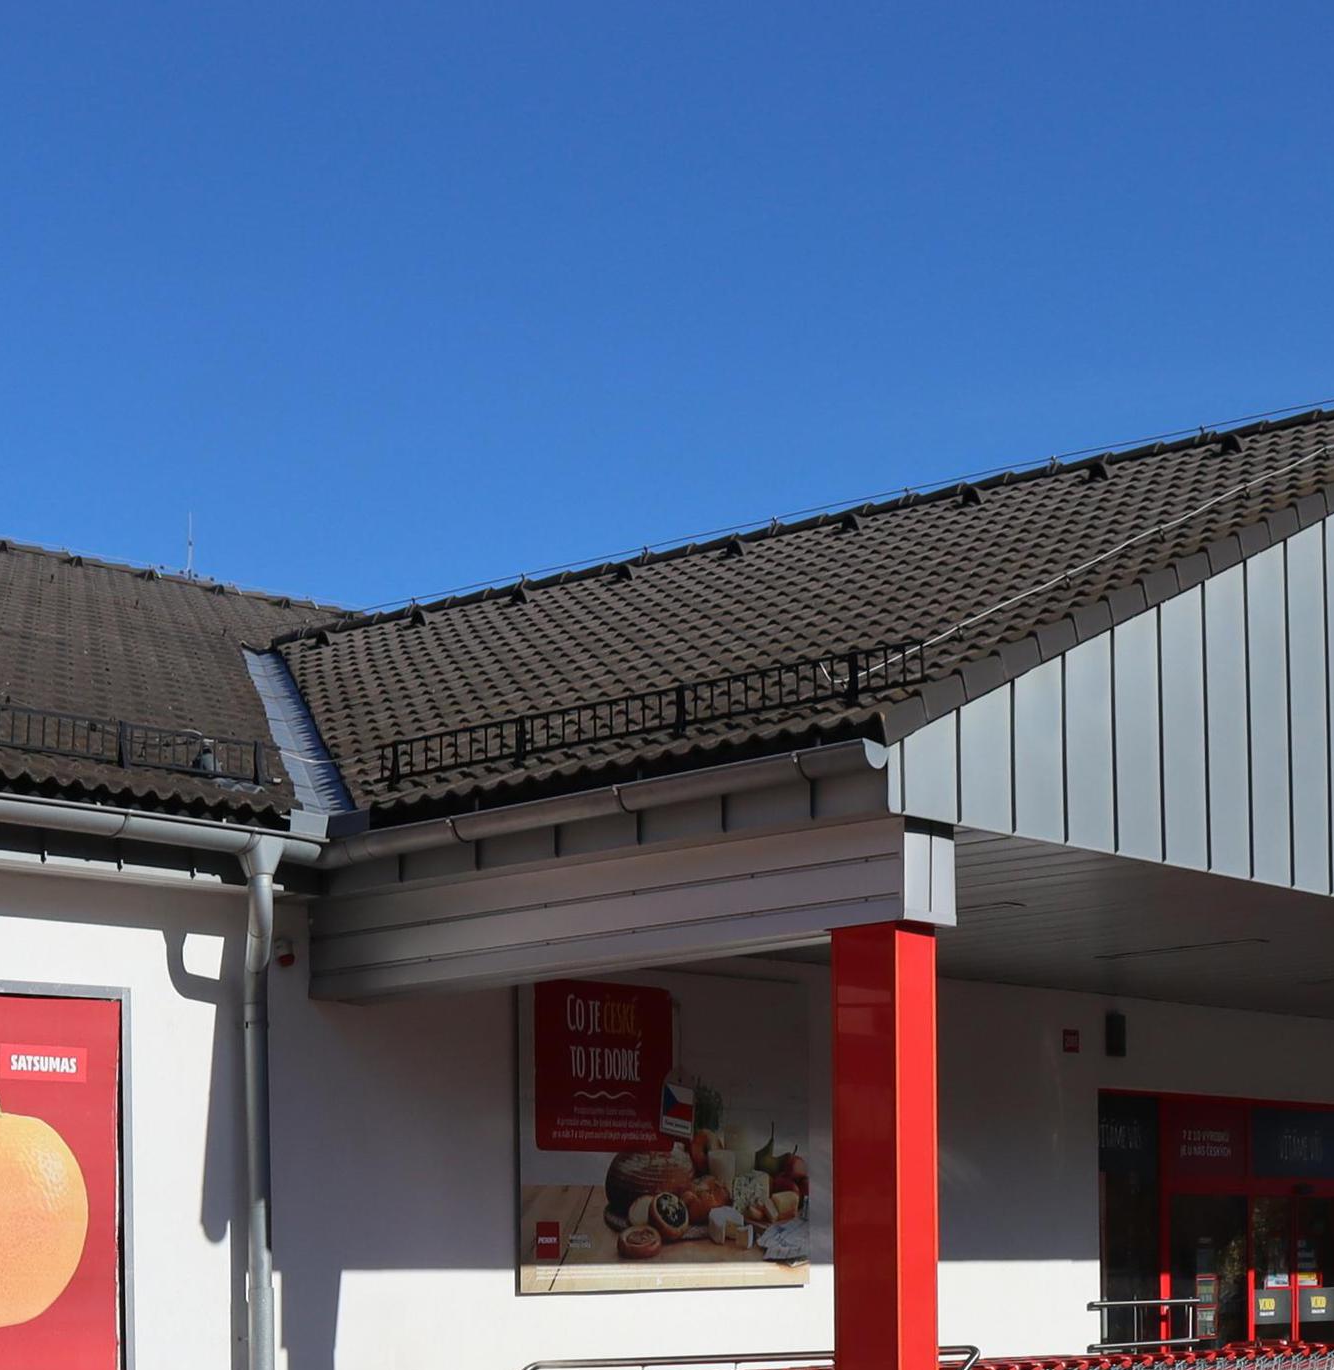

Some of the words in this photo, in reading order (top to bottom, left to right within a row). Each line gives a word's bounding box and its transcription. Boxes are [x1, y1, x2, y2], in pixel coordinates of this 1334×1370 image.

[587, 1000, 601, 1035] JE
[10, 1054, 77, 1074] SATSUMAS
[569, 1045, 586, 1078] TO
[588, 1048, 602, 1082] JE
[605, 1041, 642, 1081] DOBRÉ
